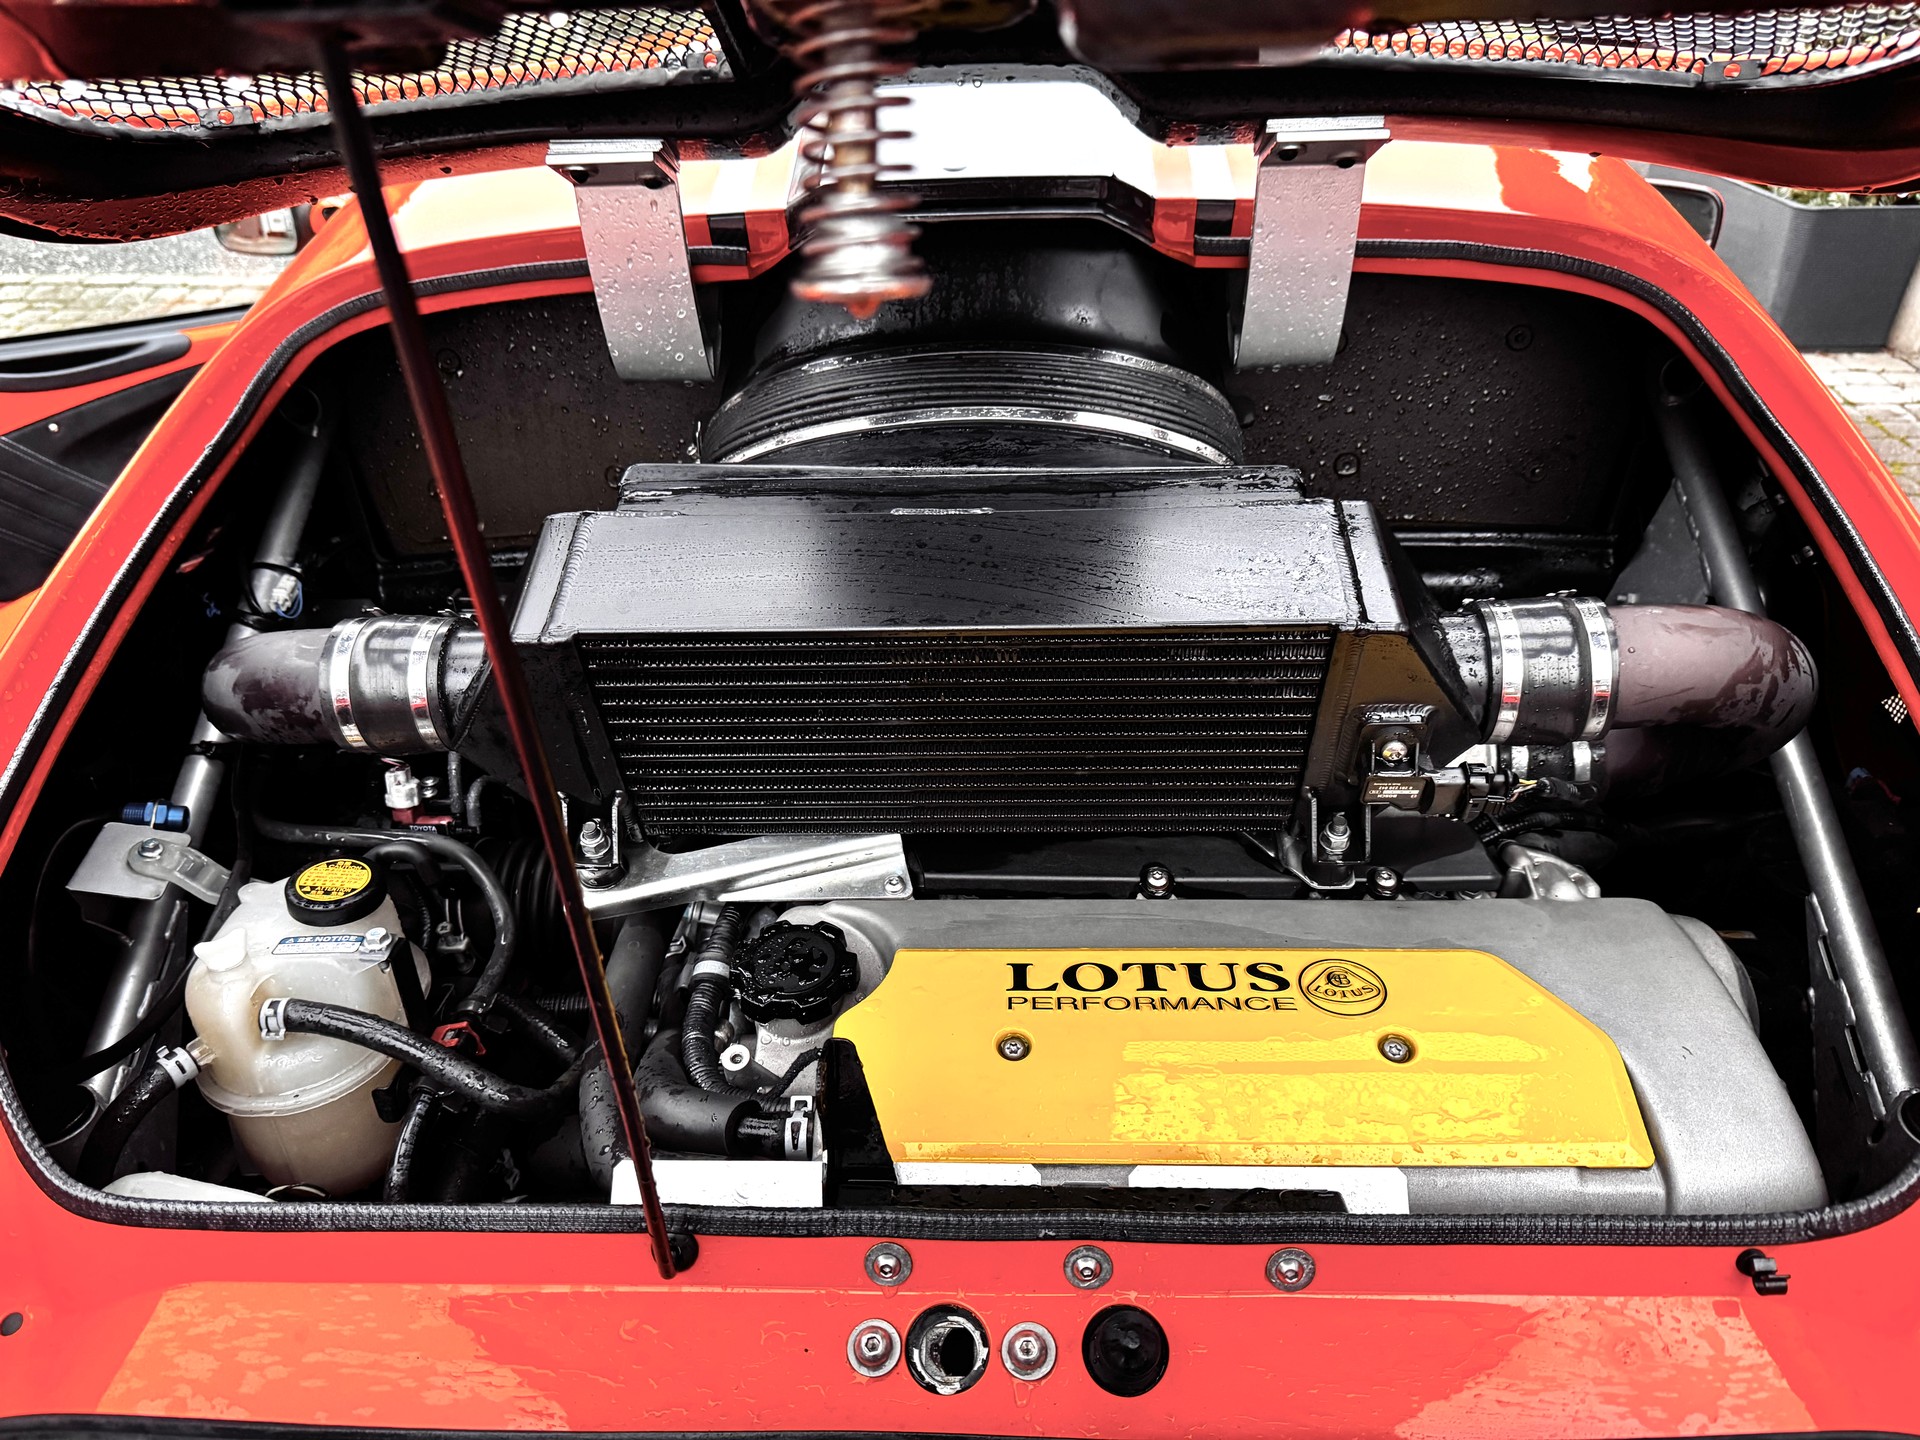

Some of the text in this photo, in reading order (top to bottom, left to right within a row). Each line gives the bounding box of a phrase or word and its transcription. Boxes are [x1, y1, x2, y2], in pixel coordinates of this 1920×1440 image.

[1005, 961, 1291, 993] LOTUS
[1313, 984, 1375, 999] LOTUS
[1007, 996, 1298, 1012] PERFORMANCE
